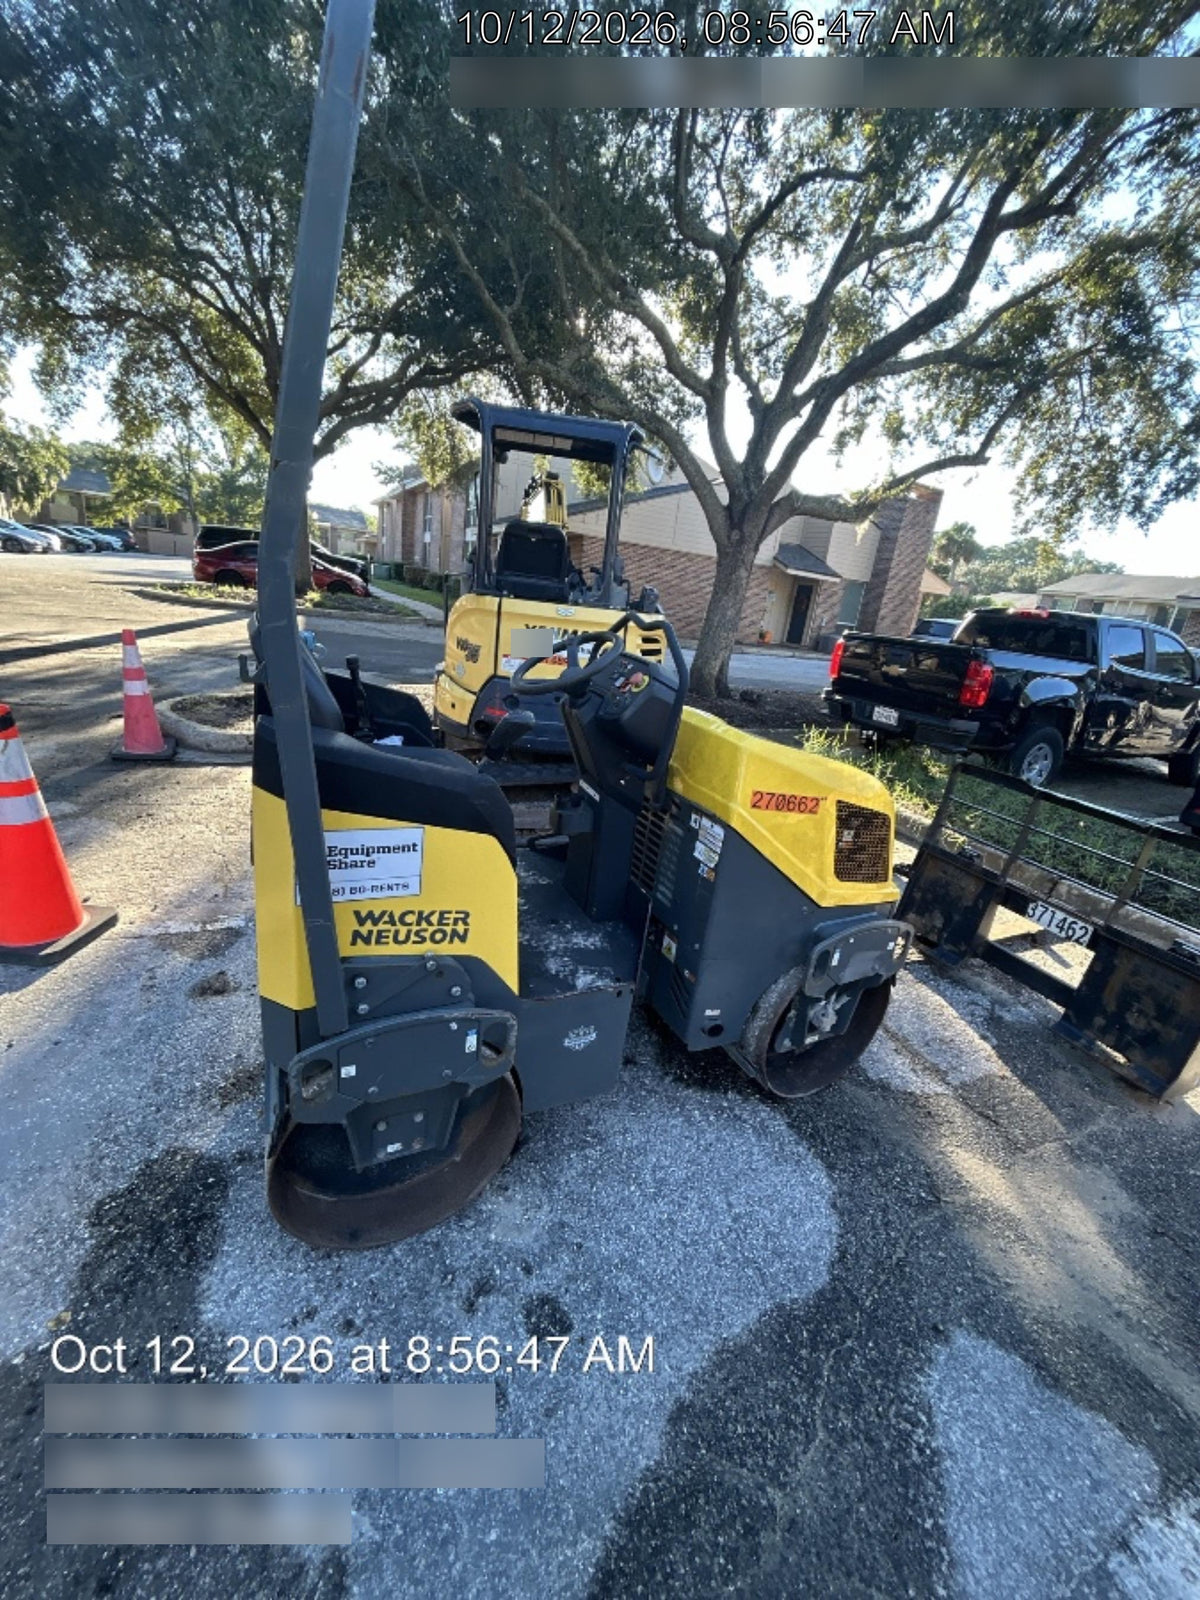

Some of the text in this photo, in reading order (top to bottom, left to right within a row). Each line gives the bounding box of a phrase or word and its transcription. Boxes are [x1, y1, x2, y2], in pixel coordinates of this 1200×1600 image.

[751, 790, 820, 814] 270662
[327, 842, 418, 859] Equipment
[327, 858, 376, 870] Share
[353, 910, 470, 927] WACKER
[1027, 901, 1090, 945] 371462
[350, 928, 470, 946] NEUSON
